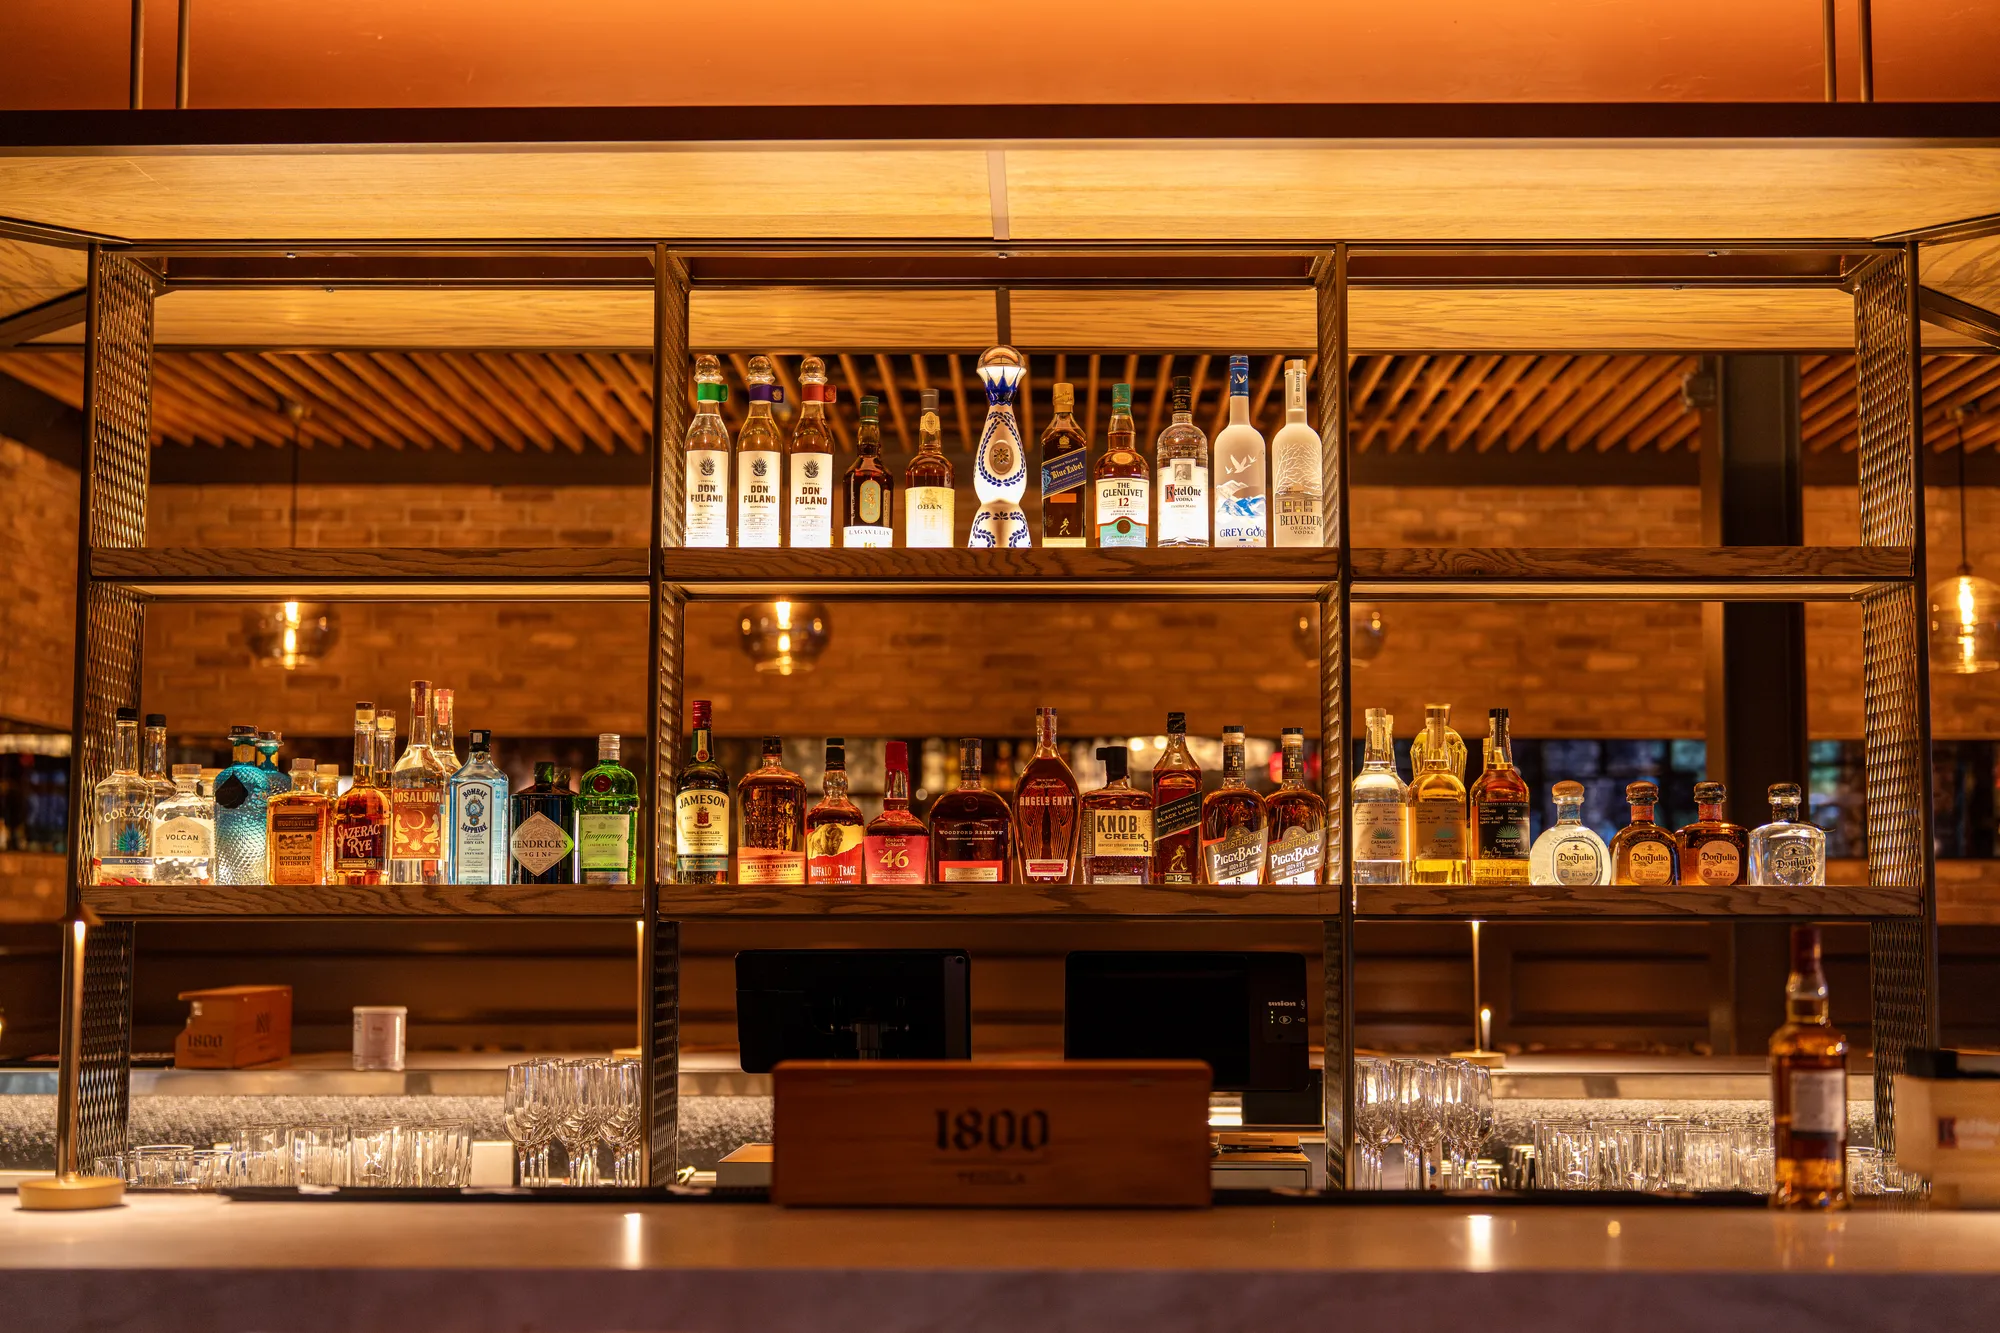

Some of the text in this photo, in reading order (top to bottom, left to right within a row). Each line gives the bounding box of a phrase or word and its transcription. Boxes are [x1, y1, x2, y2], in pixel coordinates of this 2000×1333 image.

[1050, 470, 1066, 479] Blue
[1065, 462, 1084, 474] Label
[698, 484, 716, 492] DON
[751, 485, 768, 493] DON
[1103, 489, 1143, 498] GLENLIVET
[1166, 486, 1201, 500] Ketel One
[690, 494, 723, 502] FULANO
[744, 495, 776, 503] FULANO
[795, 497, 827, 505] FULANO
[1118, 498, 1129, 506] 12
[1220, 526, 1266, 537] GREY GOO
[1232, 756, 1238, 767] 6
[1290, 758, 1296, 769] 6
[394, 792, 440, 803] ROSALUNA
[462, 788, 487, 798] BOMBAY
[680, 795, 725, 809] JAMESON
[1052, 796, 1073, 805] ENVY
[1156, 805, 1199, 823] BLACK LABEL
[461, 822, 488, 833] SAPPHIRE
[1097, 815, 1138, 832] KNOB
[336, 824, 380, 847] SAZERAC
[584, 831, 623, 841] Tanqueray
[347, 837, 372, 858] RYE
[512, 840, 568, 848] HENDRICK'S
[1143, 840, 1149, 852] 9
[880, 850, 909, 868] 46
[1213, 844, 1262, 869] PIGGYBACK
[1271, 845, 1319, 869] PIGGYBACK
[811, 865, 832, 877] BUFFALO
[839, 865, 856, 876] TRACE
[187, 1034, 223, 1048] 1800
[933, 1107, 1050, 1152] 1800
